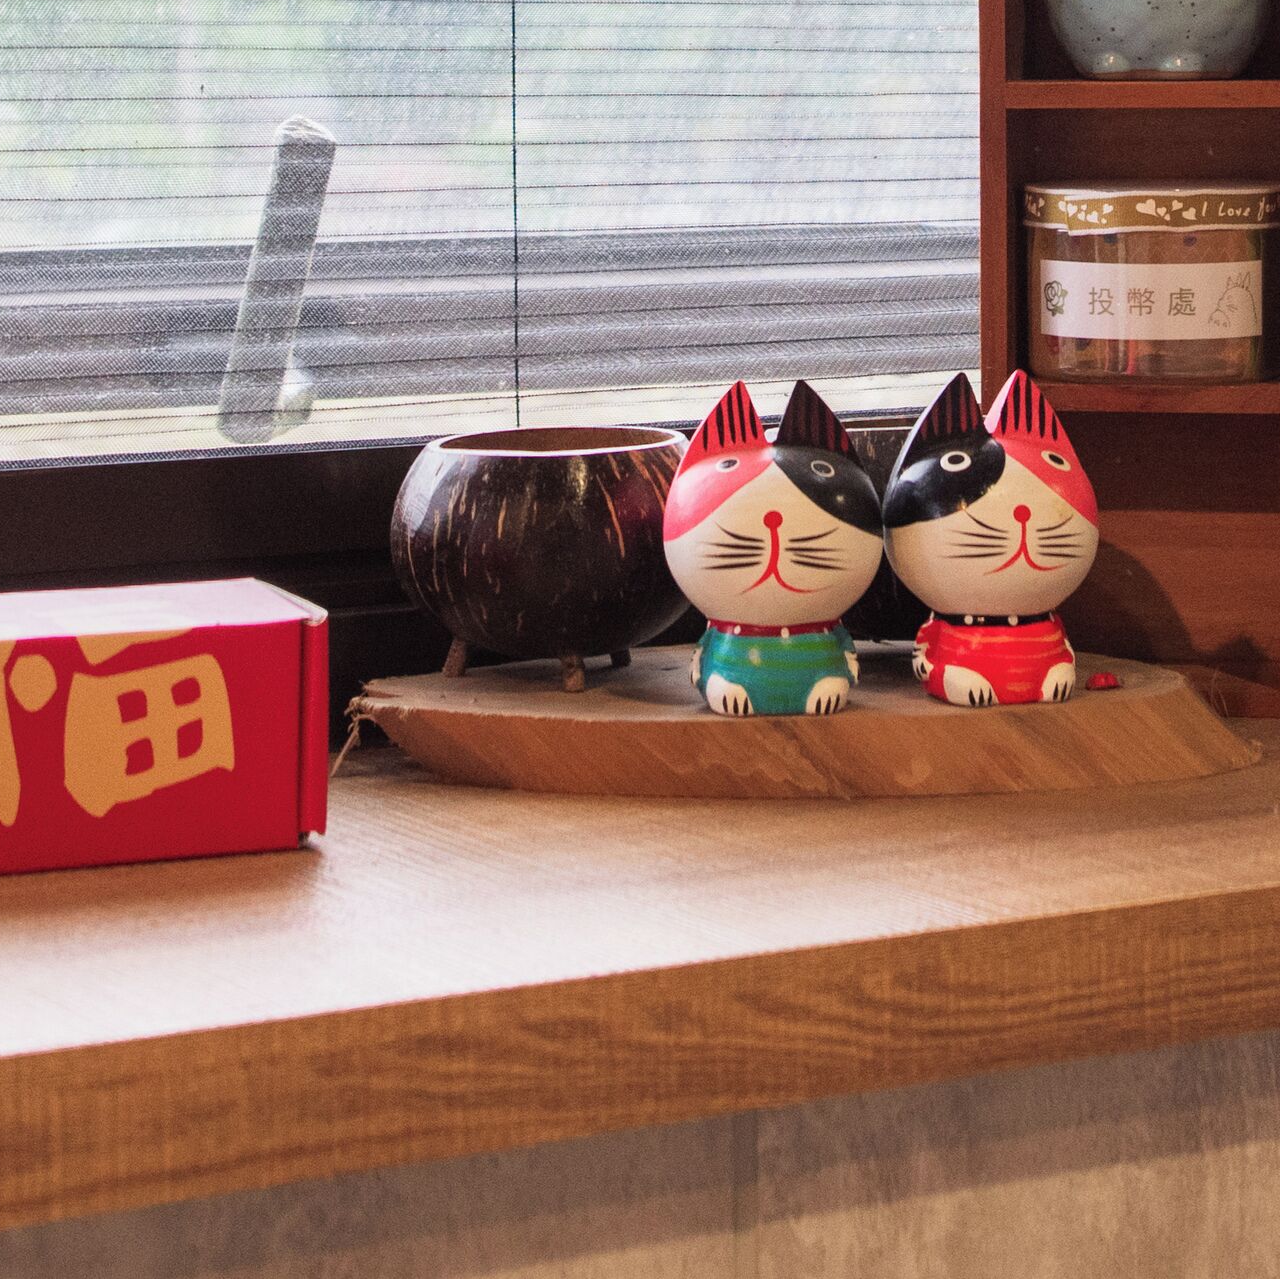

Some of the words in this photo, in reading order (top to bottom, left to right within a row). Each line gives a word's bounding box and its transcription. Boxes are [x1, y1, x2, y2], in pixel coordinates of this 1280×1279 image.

[1218, 201, 1251, 217] Love
[1088, 286, 1197, 317] 投幣處
